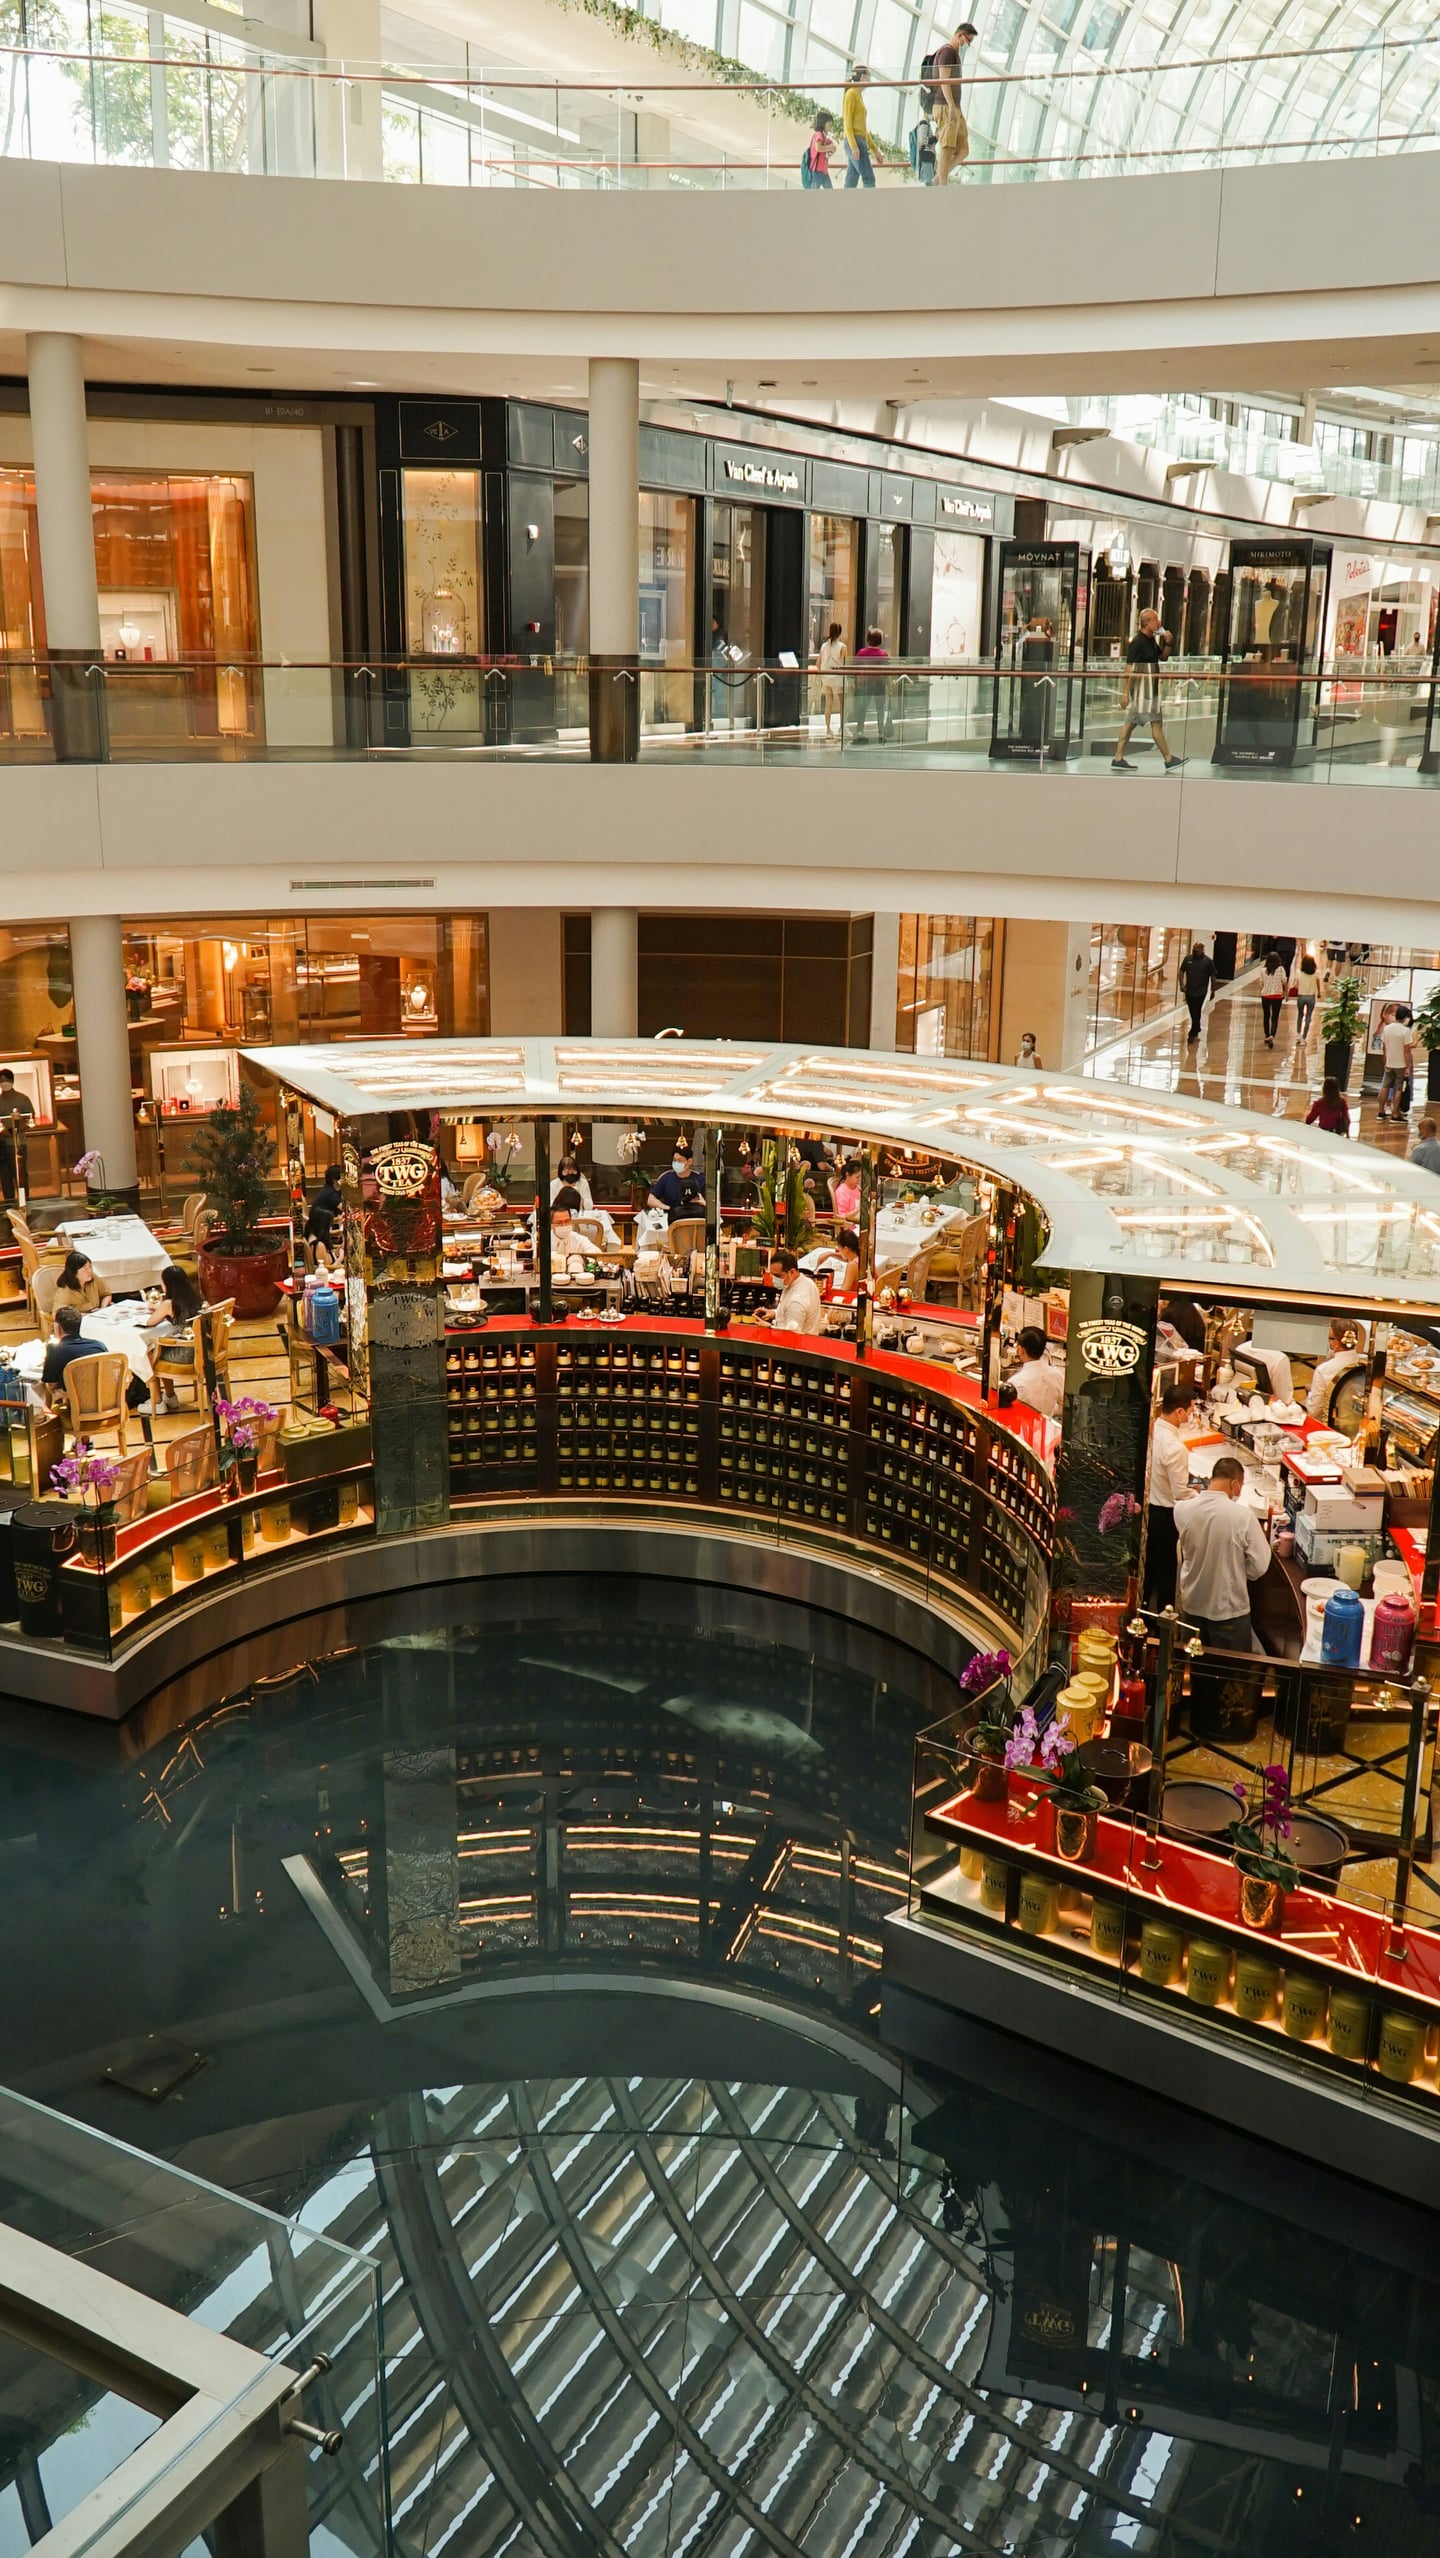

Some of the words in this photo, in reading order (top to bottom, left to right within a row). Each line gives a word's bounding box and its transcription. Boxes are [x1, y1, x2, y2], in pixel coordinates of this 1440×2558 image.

[725, 460, 743, 480] Van
[744, 463, 767, 484] Cleef
[766, 469, 774, 486] &
[774, 467, 799, 493] Arpels
[1249, 550, 1292, 559] MIKIMOTO
[391, 1156, 411, 1166] 1837
[379, 1164, 425, 1182] TWG
[390, 1179, 413, 1187] TEA
[1100, 1335, 1122, 1346] 1837
[1086, 1342, 1136, 1362] TWG
[1097, 1357, 1121, 1368] TEA
[15, 1576, 44, 1593] TWG
[1021, 1896, 1041, 1912] TWG
[1098, 1921, 1120, 1936] TWG
[1146, 1949, 1171, 1962] TWG
[1193, 1966, 1218, 1981] TWG
[1243, 1985, 1270, 1999] TWG
[1290, 2003, 1317, 2017] TWG
[1329, 2015, 1352, 2034] TWG
[1382, 2040, 1407, 2057] TWG
